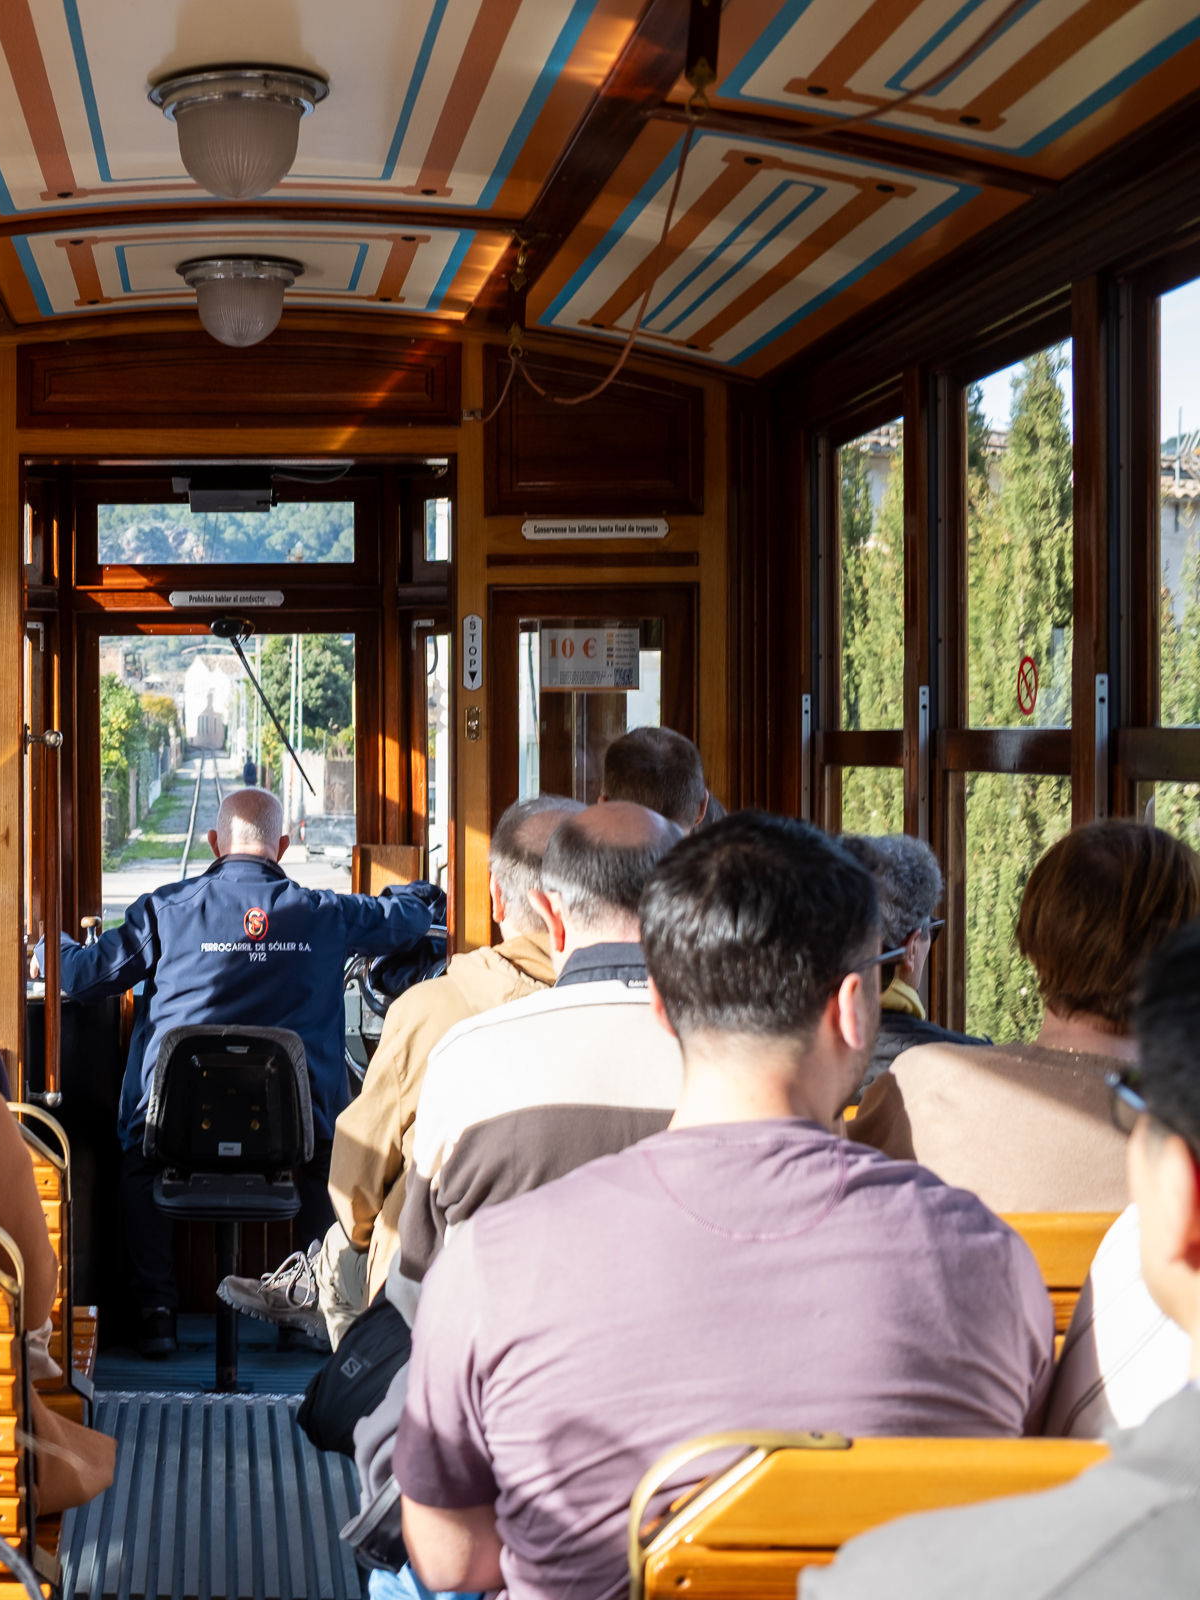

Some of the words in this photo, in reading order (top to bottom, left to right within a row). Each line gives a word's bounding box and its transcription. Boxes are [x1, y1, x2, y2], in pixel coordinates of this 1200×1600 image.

[533, 525, 567, 534] Conservense
[568, 524, 577, 534] los
[577, 524, 598, 533] billetes
[598, 524, 614, 533] hasta
[614, 523, 627, 533] final
[627, 523, 636, 533] de
[636, 523, 659, 534] trayecto
[188, 594, 214, 603] Prohibido
[215, 594, 232, 603] hablar
[232, 594, 239, 603] al
[239, 594, 266, 604] conductor
[468, 620, 478, 669] STOP
[549, 636, 575, 660] 10
[582, 636, 598, 660] €
[200, 942, 253, 953] FERROCARRIL
[254, 942, 266, 952] DE
[267, 940, 297, 951] SÓLLER
[248, 952, 268, 962] 1912
